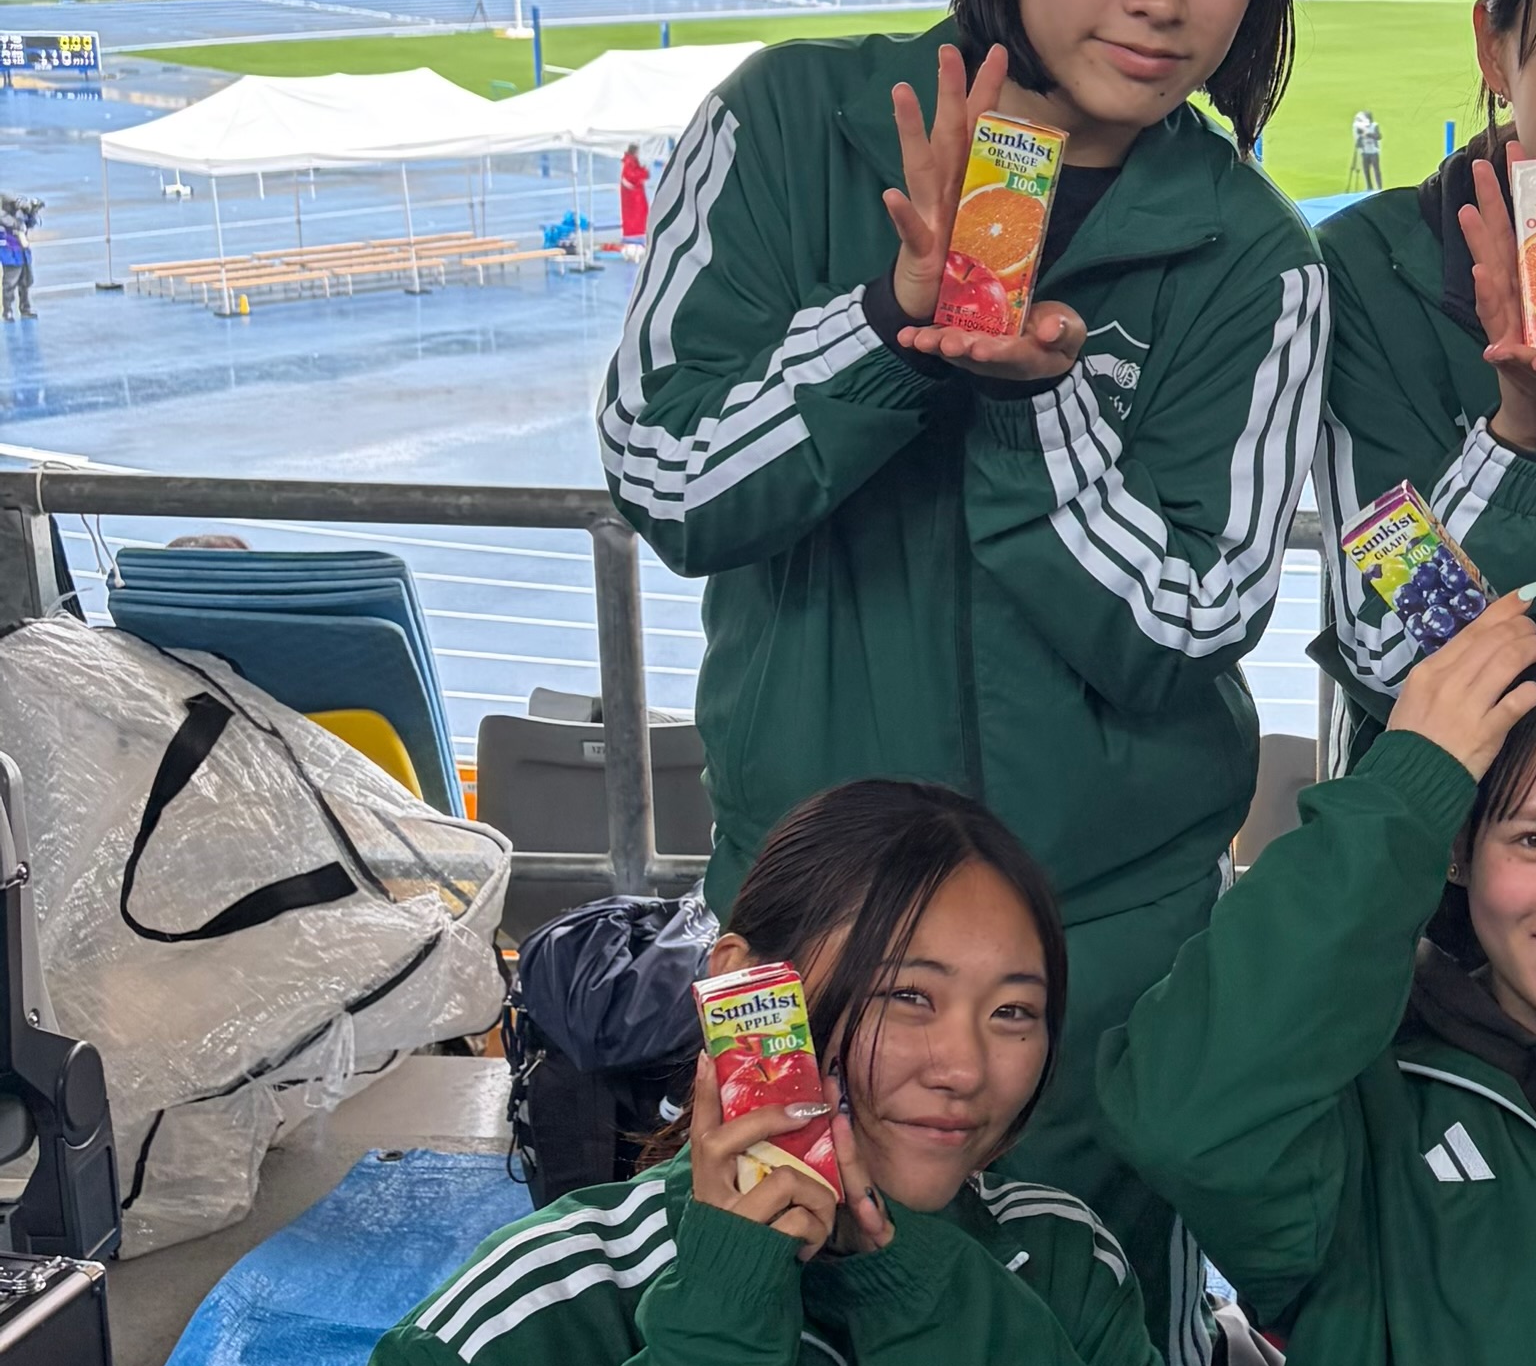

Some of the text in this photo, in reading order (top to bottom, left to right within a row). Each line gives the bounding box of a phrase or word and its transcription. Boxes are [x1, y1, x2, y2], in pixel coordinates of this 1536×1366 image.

[977, 126, 1054, 162] Sunkist
[988, 146, 1038, 168] ORANGE
[995, 158, 1027, 174] BLEND
[1352, 513, 1419, 561] Sunkist
[1375, 532, 1409, 560] GRAPE
[711, 992, 800, 1025] Sunkist
[735, 1013, 782, 1033] APPLE
